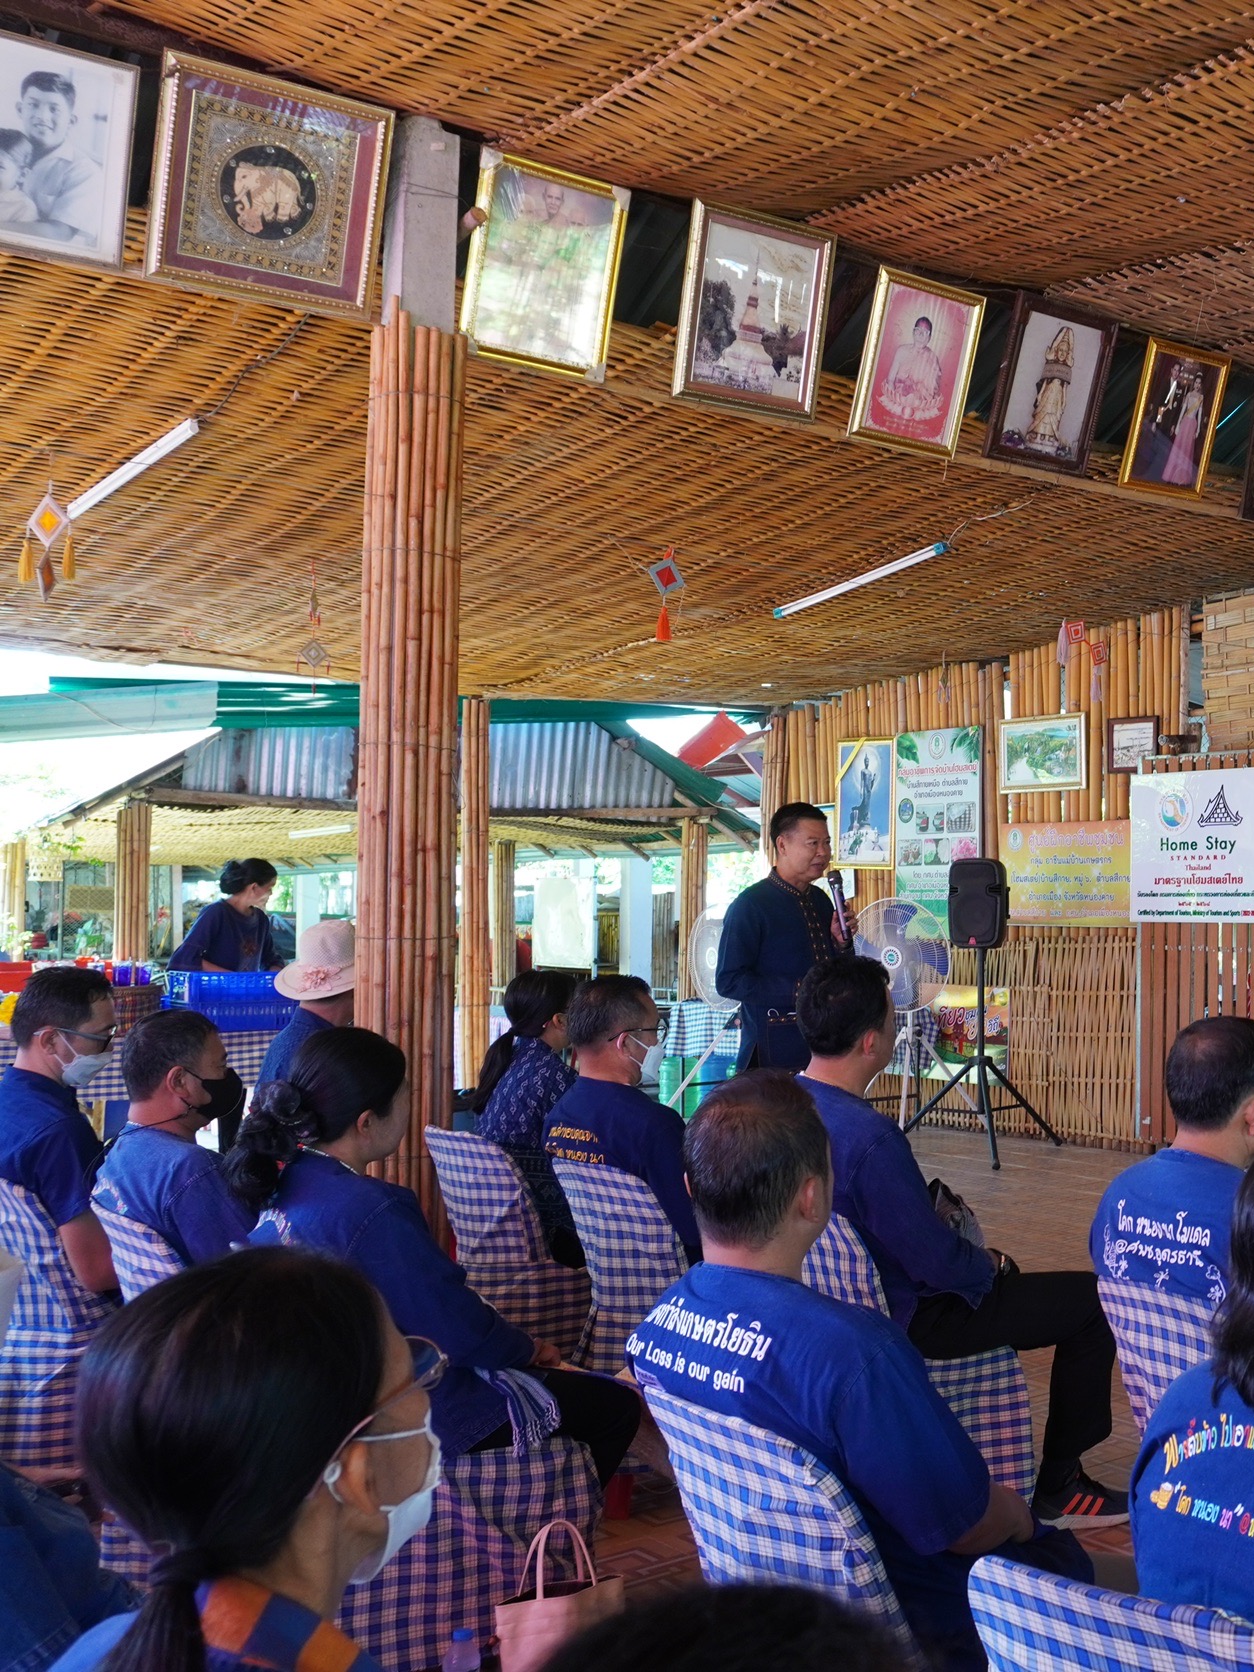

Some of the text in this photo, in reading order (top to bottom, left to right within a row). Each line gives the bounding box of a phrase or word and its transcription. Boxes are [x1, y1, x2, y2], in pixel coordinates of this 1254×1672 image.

[1160, 836, 1237, 854] Home Stay
[1185, 863, 1212, 871] Thailand
[1154, 873, 1243, 887] มาตรฐานโฮมสเตย์ไทย
[1117, 1199, 1134, 1232] โคก
[1176, 1211, 1211, 1247] โมเดล
[625, 1333, 645, 1357] Our
[645, 1340, 673, 1370] Loss
[673, 1351, 684, 1374] is
[688, 1361, 710, 1386] our
[713, 1367, 745, 1394] gain
[1191, 1498, 1220, 1524] หนอง
